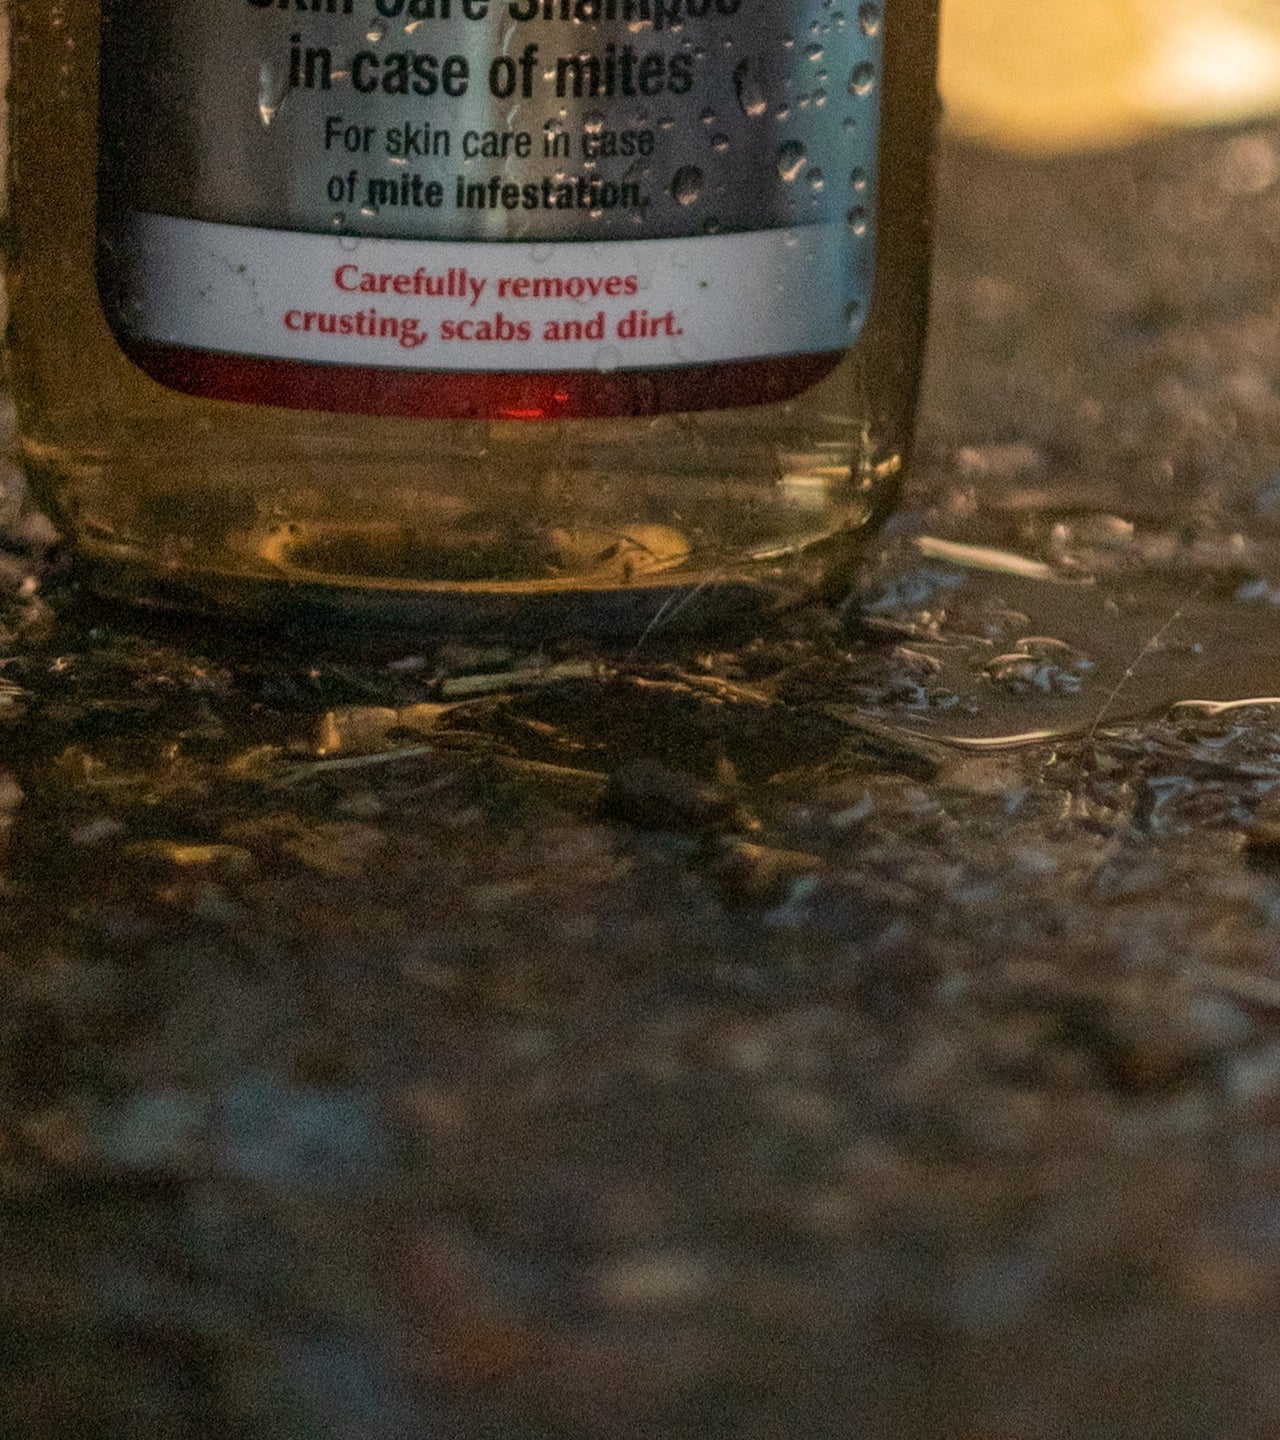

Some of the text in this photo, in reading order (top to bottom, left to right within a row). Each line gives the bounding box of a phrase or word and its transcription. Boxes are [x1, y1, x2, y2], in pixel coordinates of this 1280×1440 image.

[289, 33, 694, 99] in case of mites
[325, 116, 656, 158] For skin care in case
[327, 170, 650, 210] of mite infestation.
[334, 264, 639, 307] Carefully removes
[284, 308, 684, 349] crusting, scabs and dirt.
